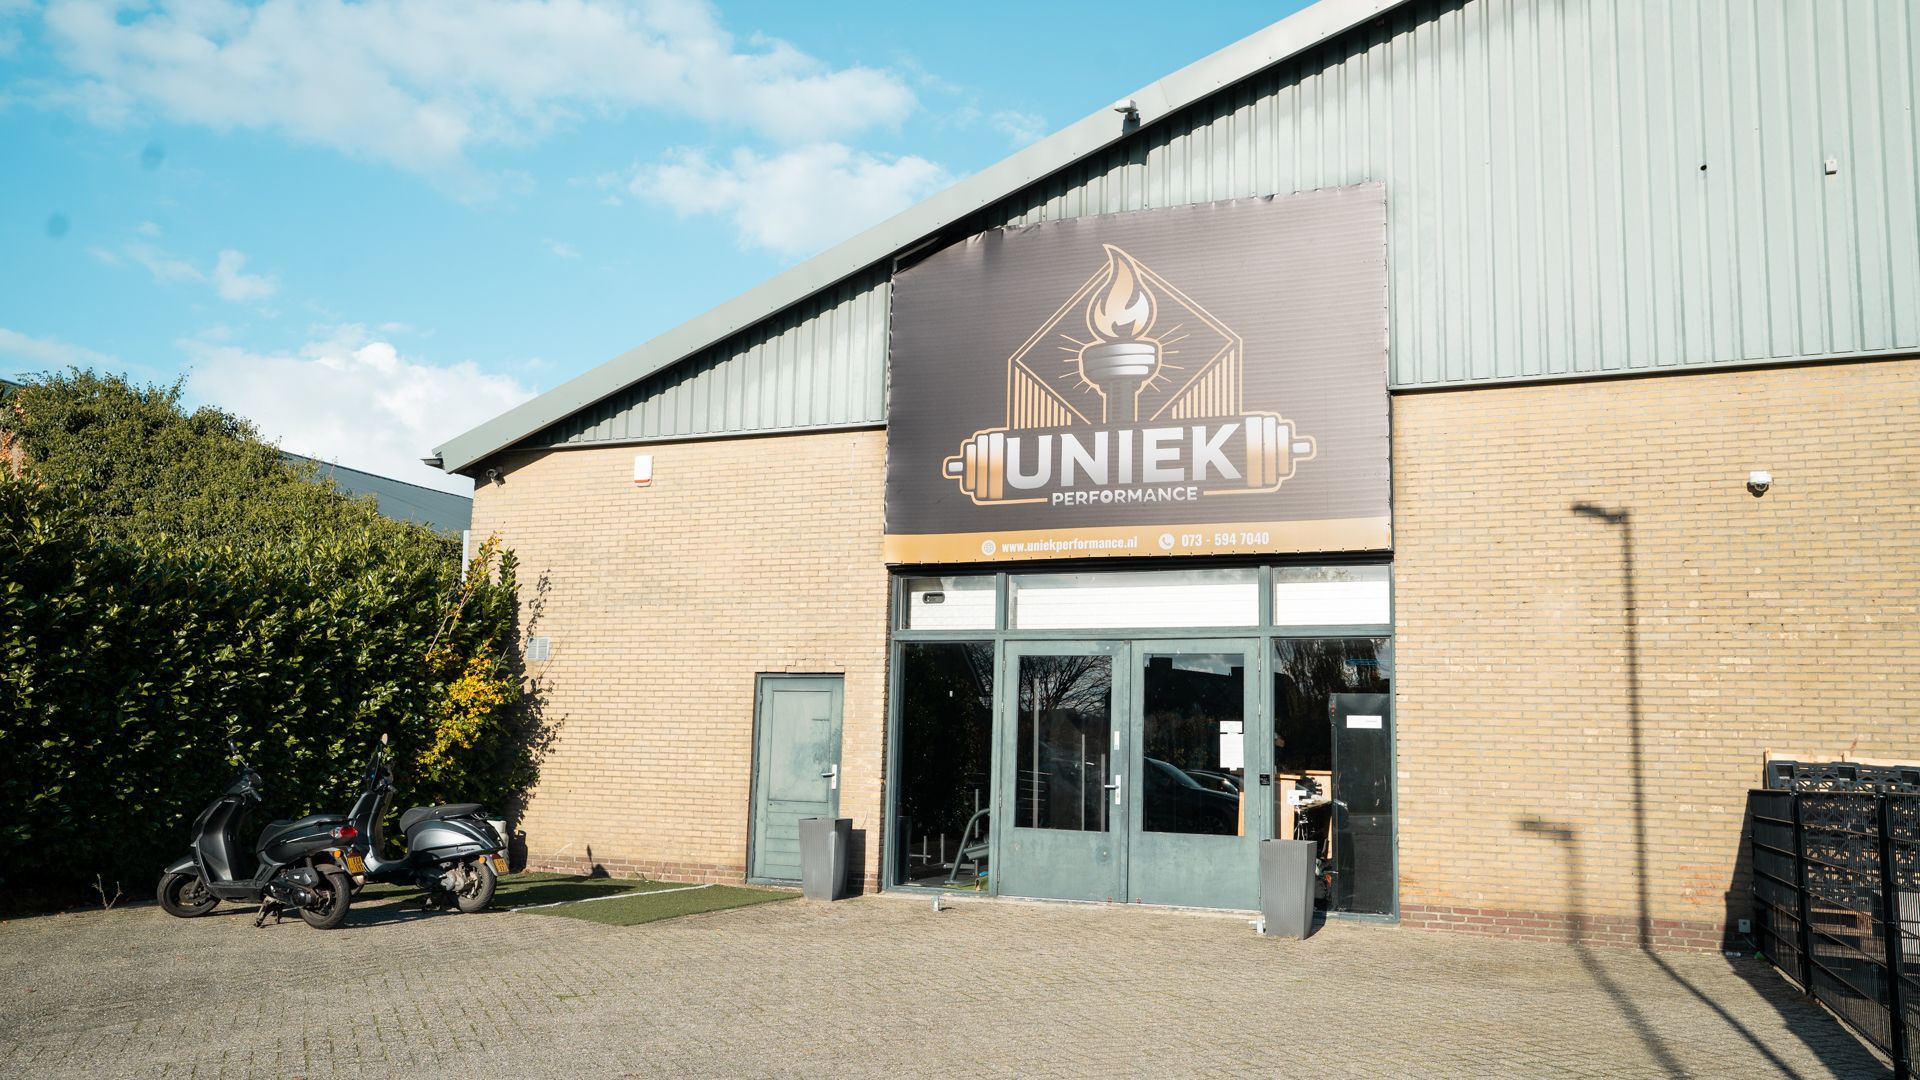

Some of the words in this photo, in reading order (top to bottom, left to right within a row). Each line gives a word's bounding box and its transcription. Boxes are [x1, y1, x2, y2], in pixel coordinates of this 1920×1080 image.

[1006, 423, 1242, 490] UNIEK
[1052, 486, 1198, 506] PERFORMANCE
[1001, 536, 1138, 553] www.uniekperformance.nl
[1181, 534, 1202, 547] 073
[1214, 533, 1236, 546] 594
[1240, 532, 1270, 545] 7040
